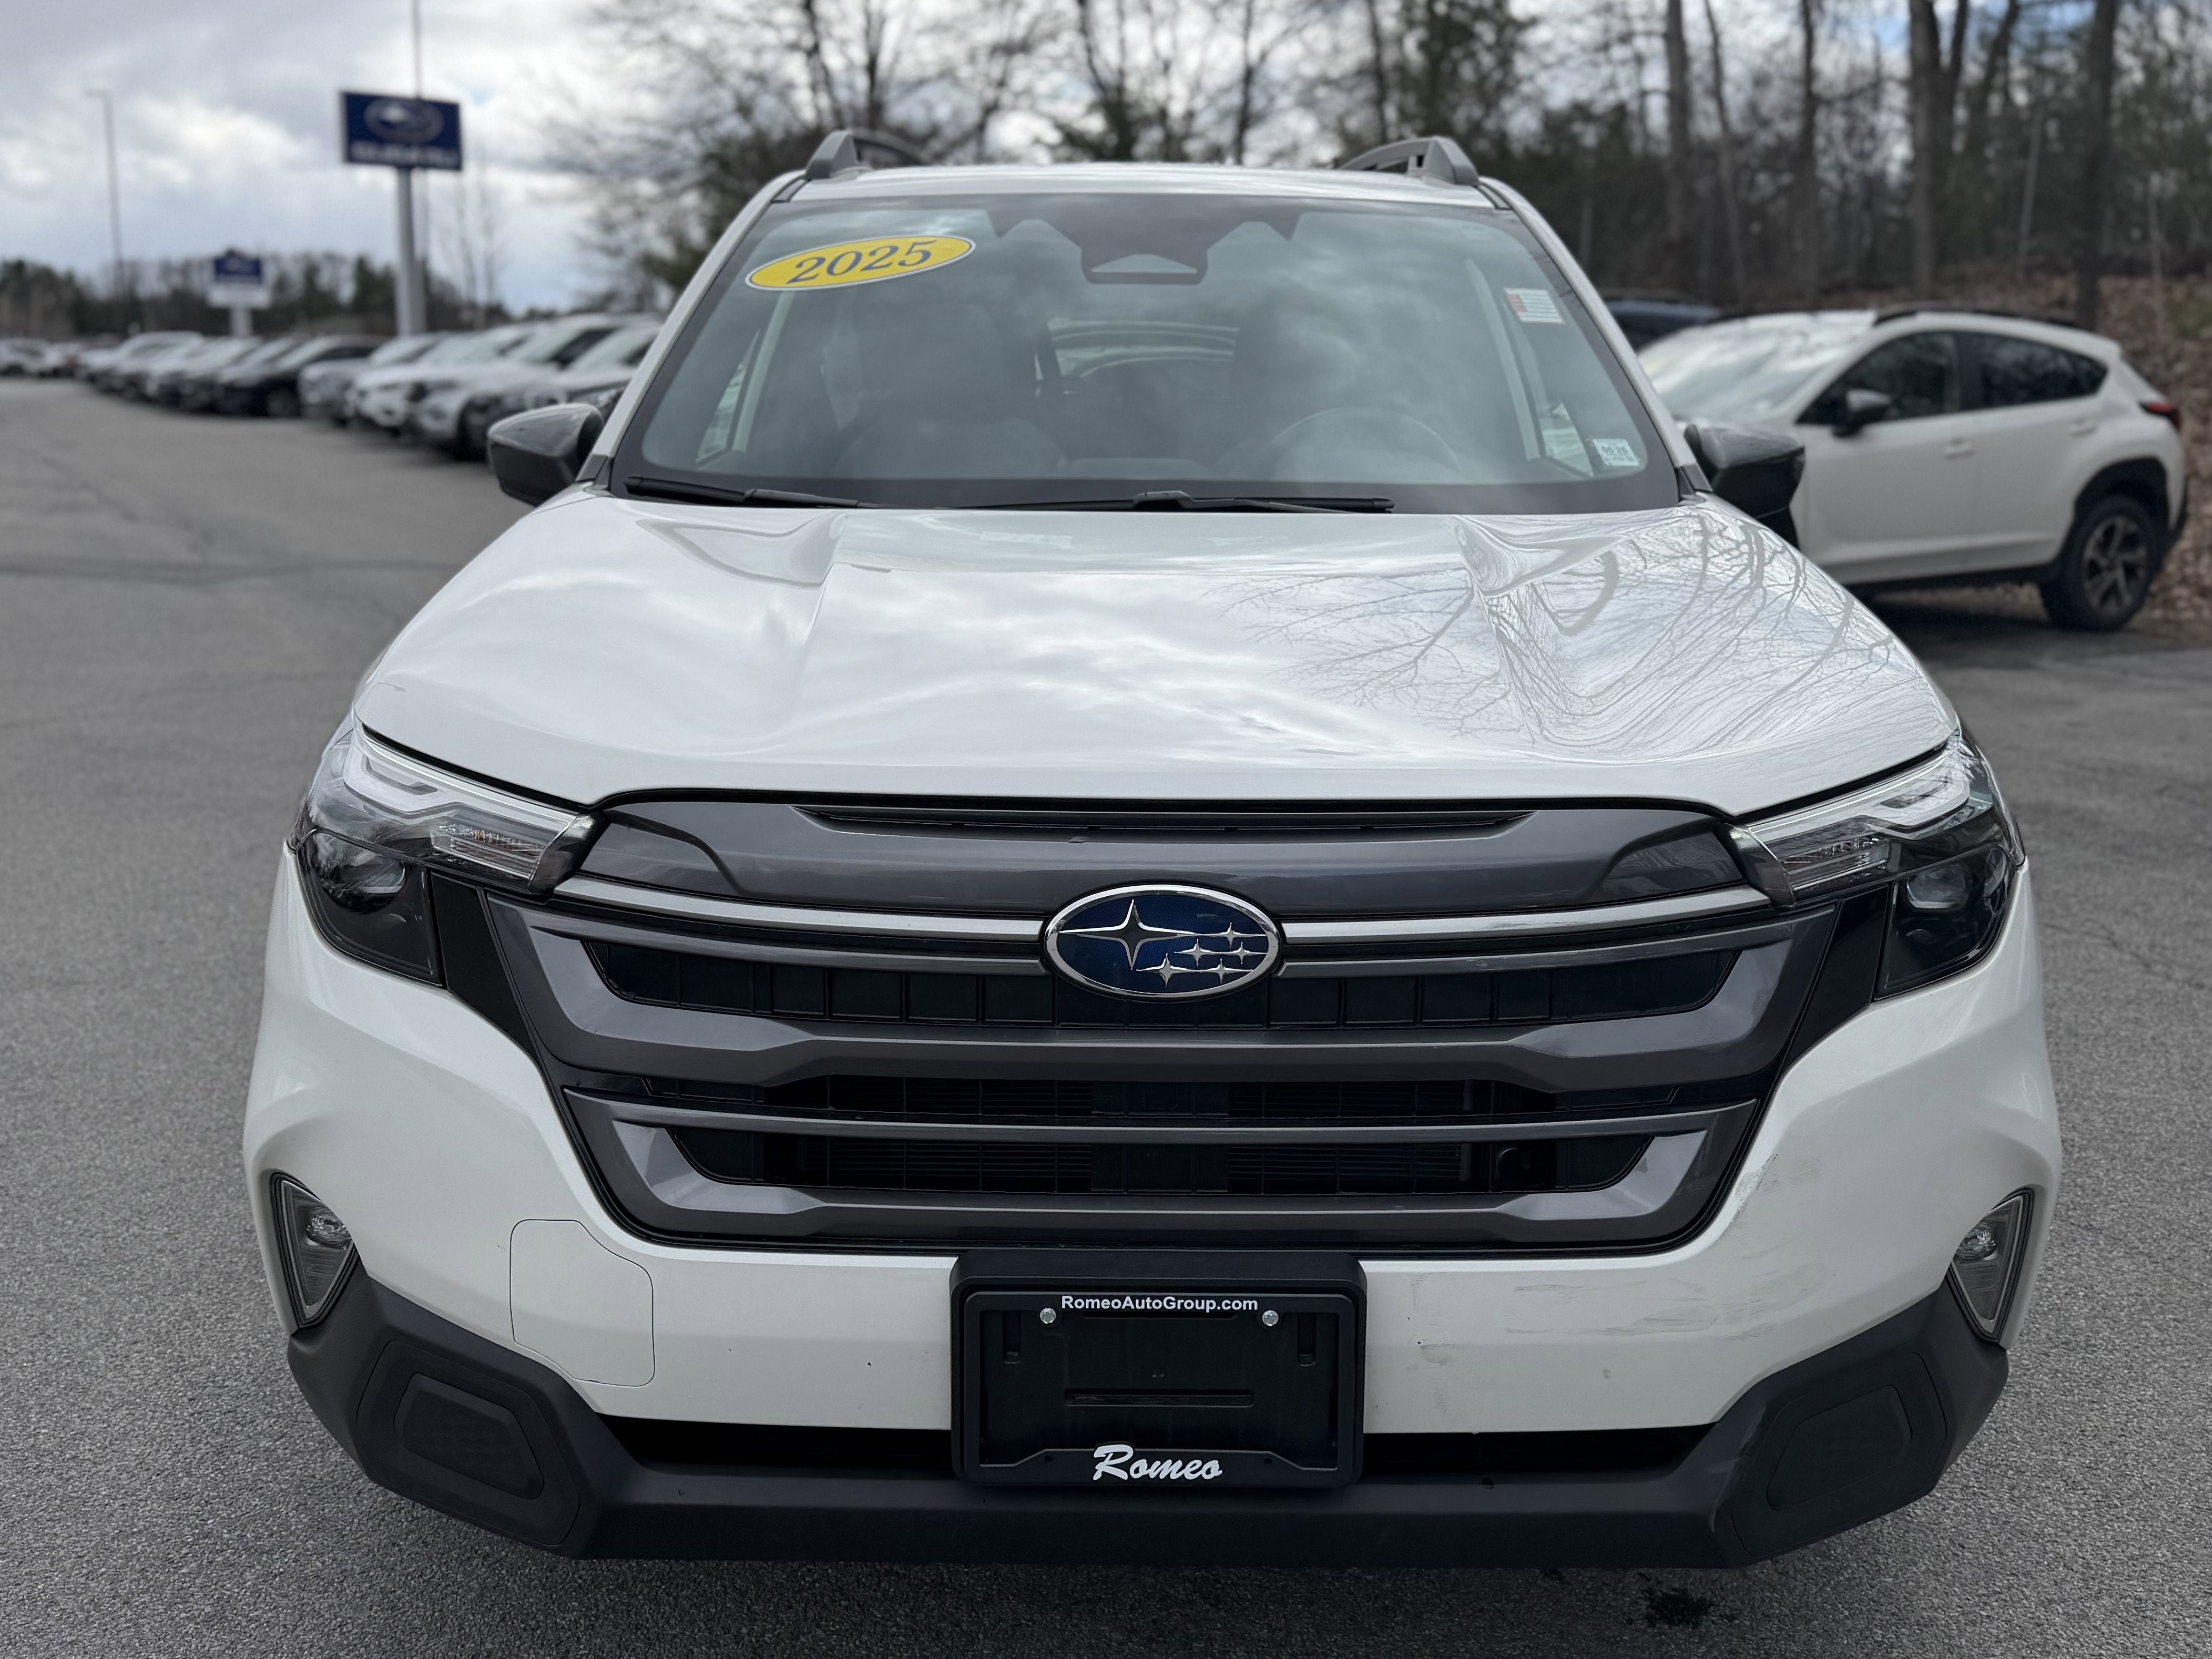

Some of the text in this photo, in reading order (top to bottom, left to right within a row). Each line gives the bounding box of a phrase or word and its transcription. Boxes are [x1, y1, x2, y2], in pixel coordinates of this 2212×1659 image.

[787, 240, 937, 284] 2025
[1062, 1296, 1258, 1313] RomeoAutoGroup.com
[1092, 1444, 1223, 1481] Romeo
